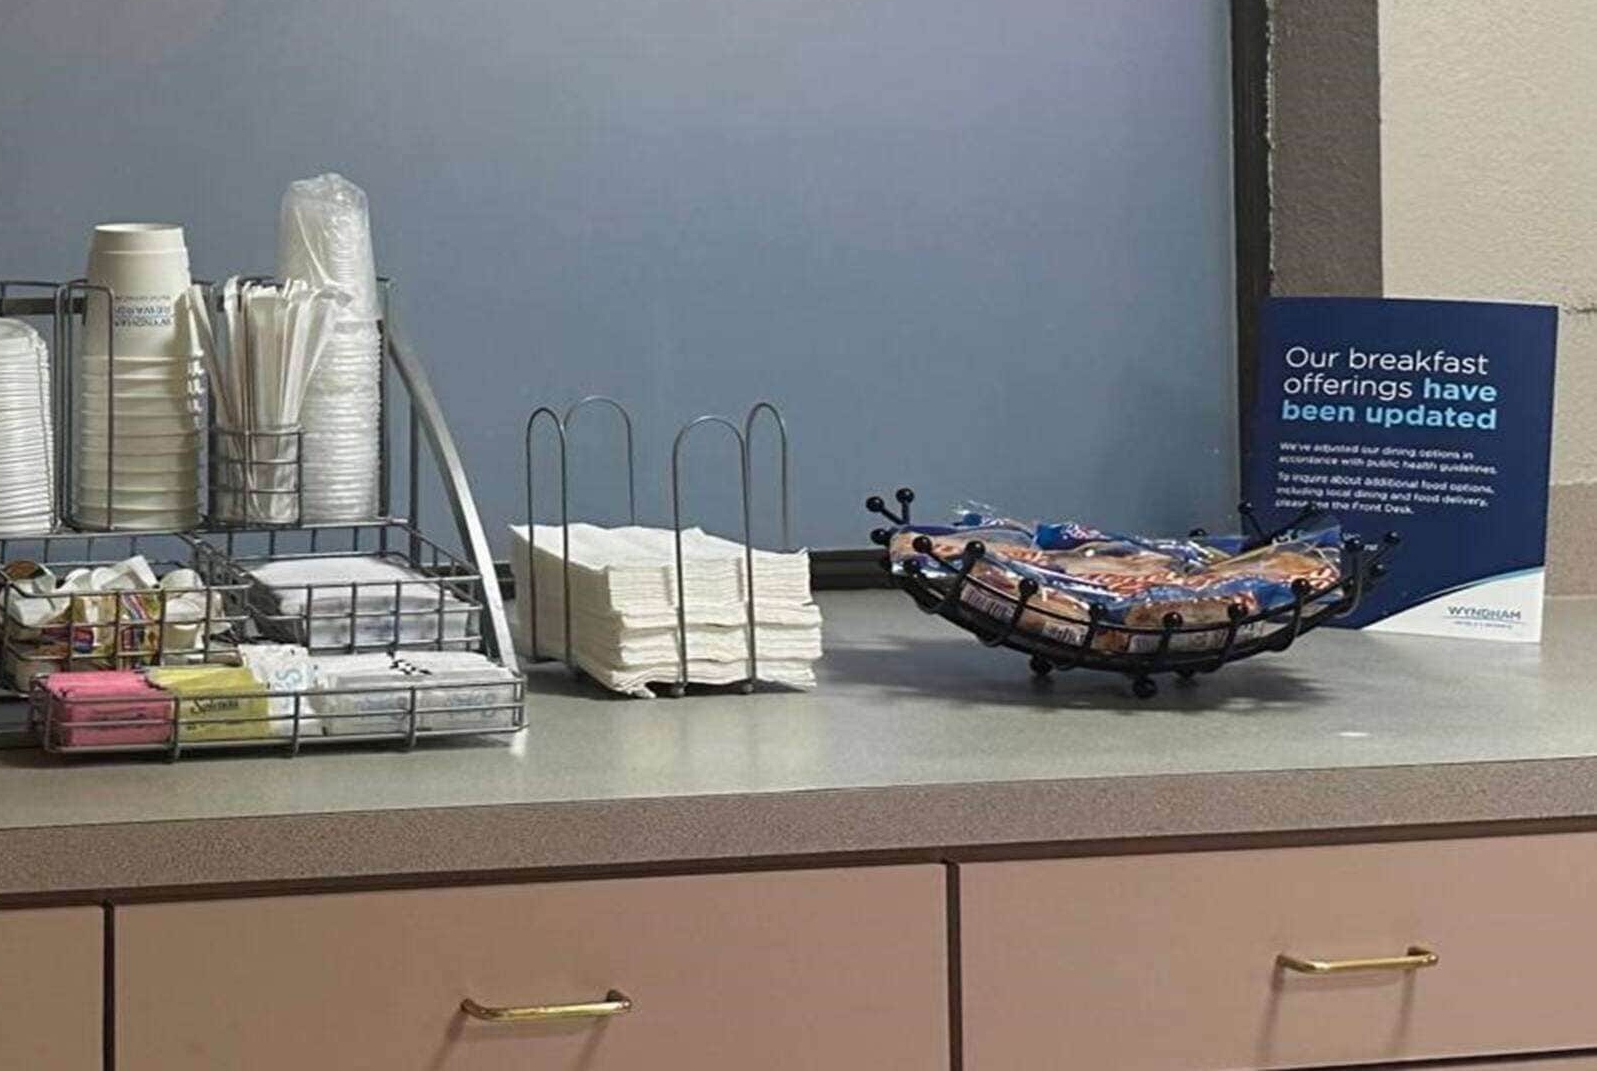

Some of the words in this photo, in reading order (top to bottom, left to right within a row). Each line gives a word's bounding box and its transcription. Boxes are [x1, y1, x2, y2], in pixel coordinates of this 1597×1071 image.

[1285, 346, 1338, 368] Our
[1349, 348, 1489, 375] breakfast
[1283, 373, 1412, 401] offerings
[1423, 379, 1498, 402] have
[1282, 400, 1354, 422] been
[1365, 405, 1497, 429] updated
[1314, 444, 1359, 454] adjusted
[1361, 446, 1380, 454] our
[1382, 447, 1416, 458] dining
[1418, 449, 1460, 460] options
[1462, 451, 1474, 460] in
[1279, 455, 1338, 465] accordance
[1341, 457, 1365, 466] with
[1366, 458, 1400, 469] public
[1402, 460, 1437, 470] health
[1278, 471, 1290, 482] To
[1292, 473, 1328, 484] inquire
[1329, 475, 1362, 485] about
[1364, 476, 1419, 489] additional
[1421, 479, 1448, 490] food
[1276, 486, 1324, 497] including
[1326, 488, 1351, 497] local
[1353, 490, 1388, 501] dining
[1390, 492, 1412, 501] and
[1414, 492, 1440, 503] food
[1331, 501, 1350, 509] the
[1352, 501, 1382, 512] Front
[1447, 606, 1521, 620] WYNDHAM
